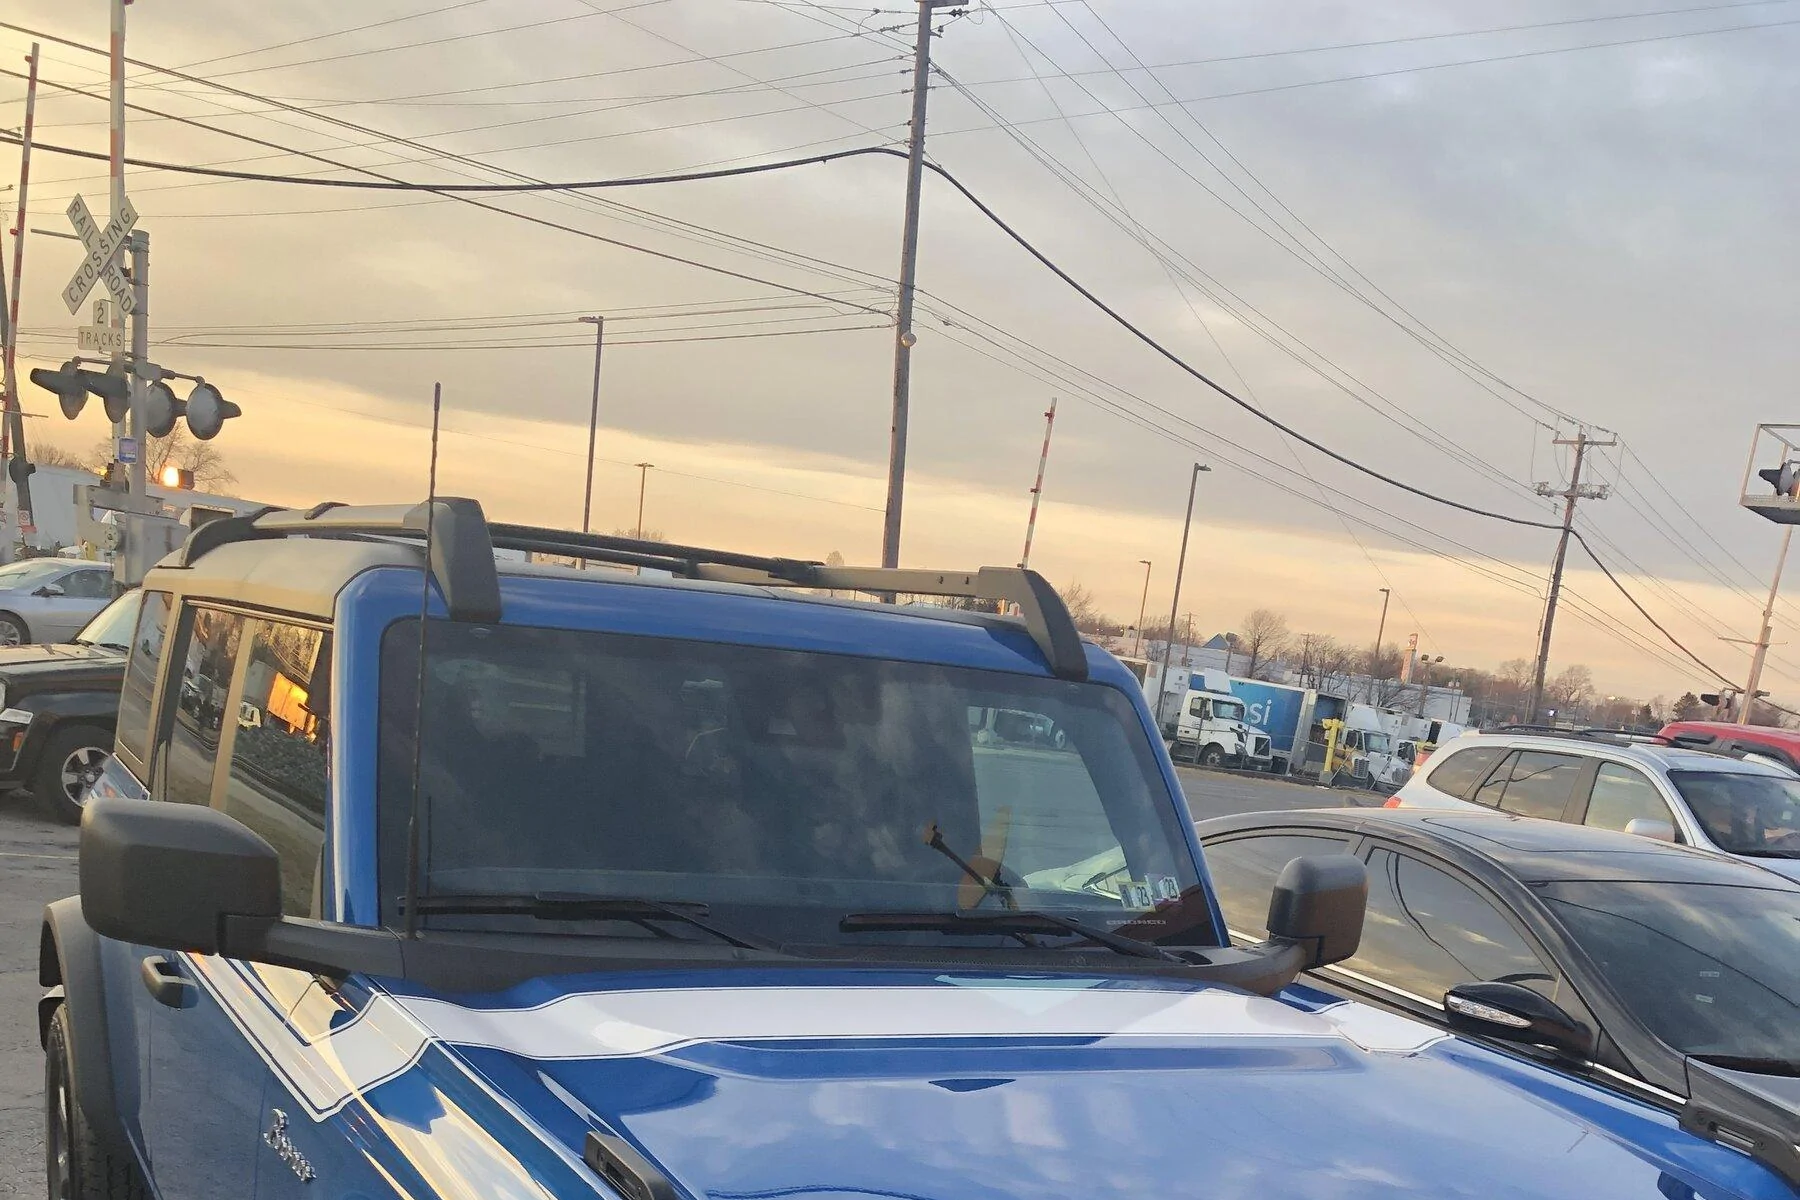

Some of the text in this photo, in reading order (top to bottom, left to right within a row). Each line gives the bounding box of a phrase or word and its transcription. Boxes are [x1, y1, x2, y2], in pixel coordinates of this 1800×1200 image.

[69, 206, 132, 303] CROSSING
[69, 201, 133, 313] RAIL ROAD
[79, 330, 123, 348] TRACKS
[96, 306, 105, 325] 2
